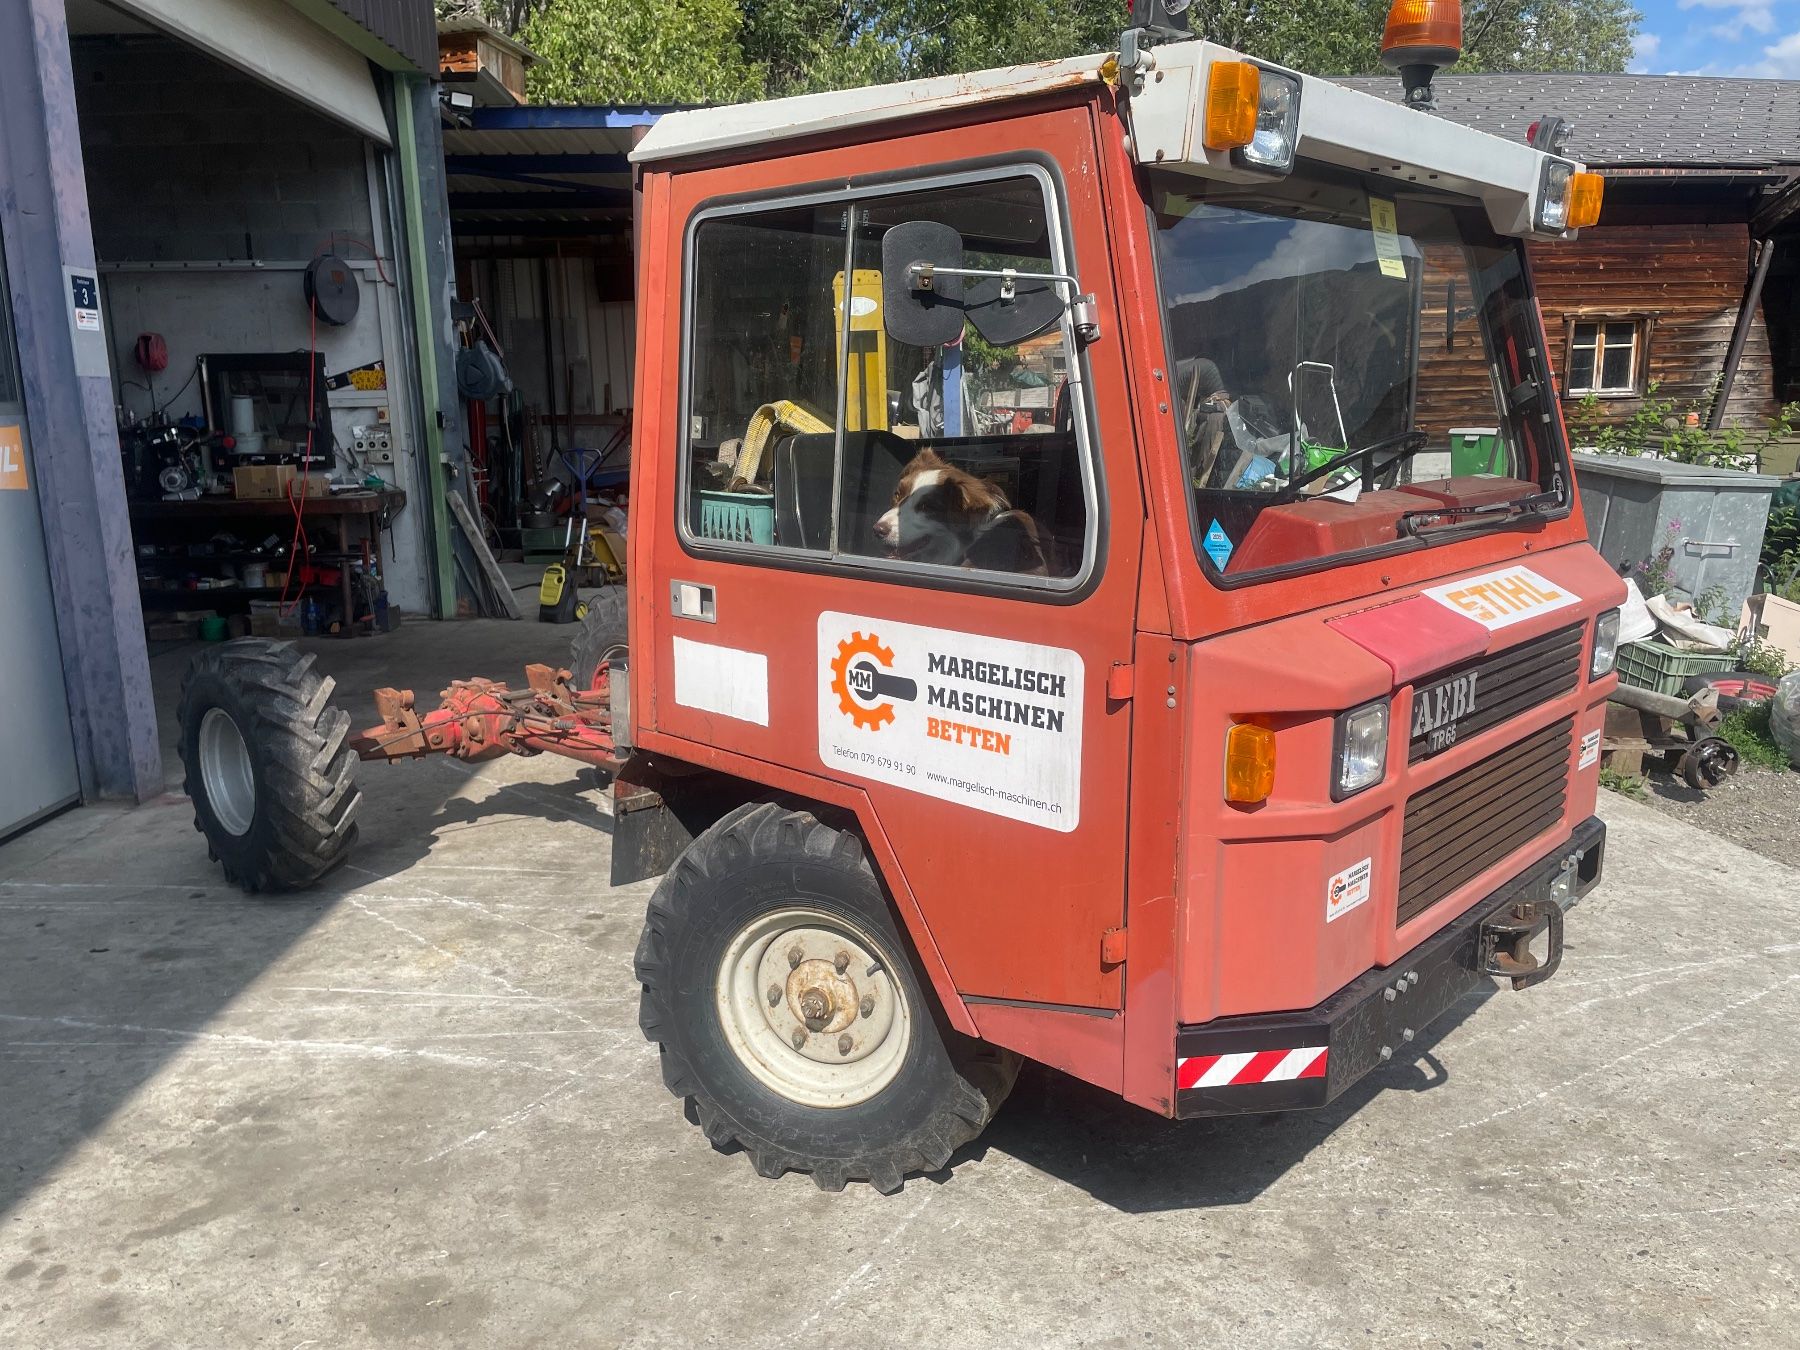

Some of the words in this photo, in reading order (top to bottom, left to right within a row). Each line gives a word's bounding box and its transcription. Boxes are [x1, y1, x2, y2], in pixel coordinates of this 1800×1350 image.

[81, 287, 89, 306] 3
[1445, 574, 1563, 621] STIHL
[848, 669, 872, 690] MM
[927, 652, 1066, 698] MARGELISCH
[927, 684, 1065, 733] MASCHINEN
[1412, 671, 1478, 738] AEBI
[926, 716, 1012, 755] BETTEN
[832, 744, 859, 760] Telefon
[860, 752, 875, 765] 079
[877, 756, 892, 769] 679
[893, 760, 903, 772] 91
[906, 764, 916, 775] 90
[926, 771, 1063, 814] www.margelisch-maschinen.ch
